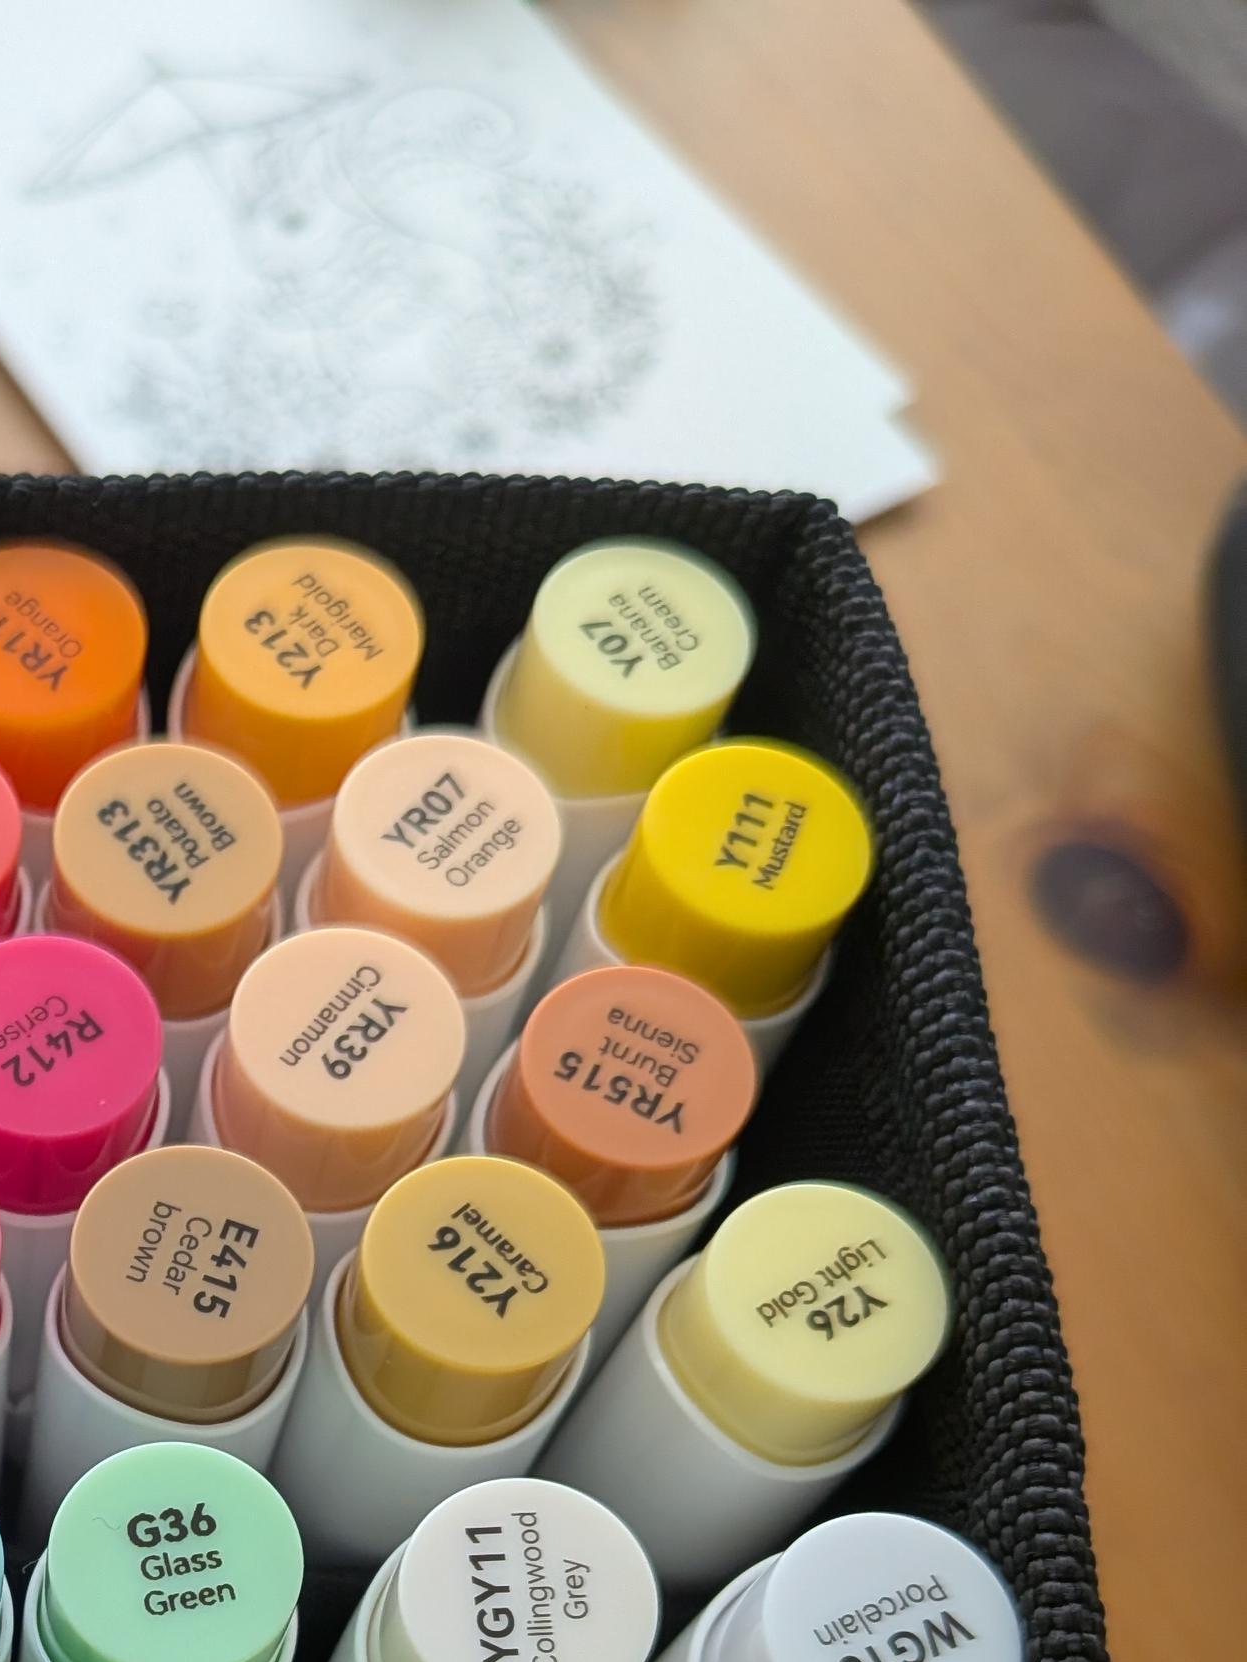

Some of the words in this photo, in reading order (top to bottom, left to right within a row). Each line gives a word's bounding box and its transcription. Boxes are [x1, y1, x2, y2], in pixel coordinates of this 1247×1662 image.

[2, 590, 84, 659] Orange
[243, 608, 325, 690] Y213
[288, 605, 338, 658] Dark
[292, 572, 385, 662] Marigold
[579, 617, 643, 680] Y07
[608, 592, 679, 672] Banana
[637, 583, 700, 653] Cream
[146, 799, 210, 869] Potato
[173, 782, 237, 852] Brown
[380, 772, 469, 853] YR07
[415, 799, 497, 873] Salmon
[713, 791, 776, 872] Y111
[750, 801, 809, 891] Mustard
[97, 800, 192, 906] YR313
[443, 817, 524, 889] Orange
[0, 1010, 106, 1088] R412
[278, 964, 383, 1068] Cinnamon
[320, 995, 409, 1082] YR39
[606, 1007, 701, 1065] Sienna
[553, 1050, 686, 1135] YR515
[599, 1034, 680, 1088] Burnt
[125, 1200, 183, 1285] brown
[161, 1215, 213, 1296] Cedar
[193, 1218, 260, 1320] E415
[425, 1226, 519, 1320] Y216
[450, 1202, 550, 1296] Caramel
[815, 1238, 890, 1290] Light
[755, 1278, 820, 1329] Gold
[805, 1285, 889, 1342] Y26
[126, 1502, 218, 1549] G36
[140, 1549, 224, 1582] Glass
[143, 1581, 237, 1617] Green
[563, 1559, 592, 1621] Grey
[813, 1574, 948, 1648] Porcelain
